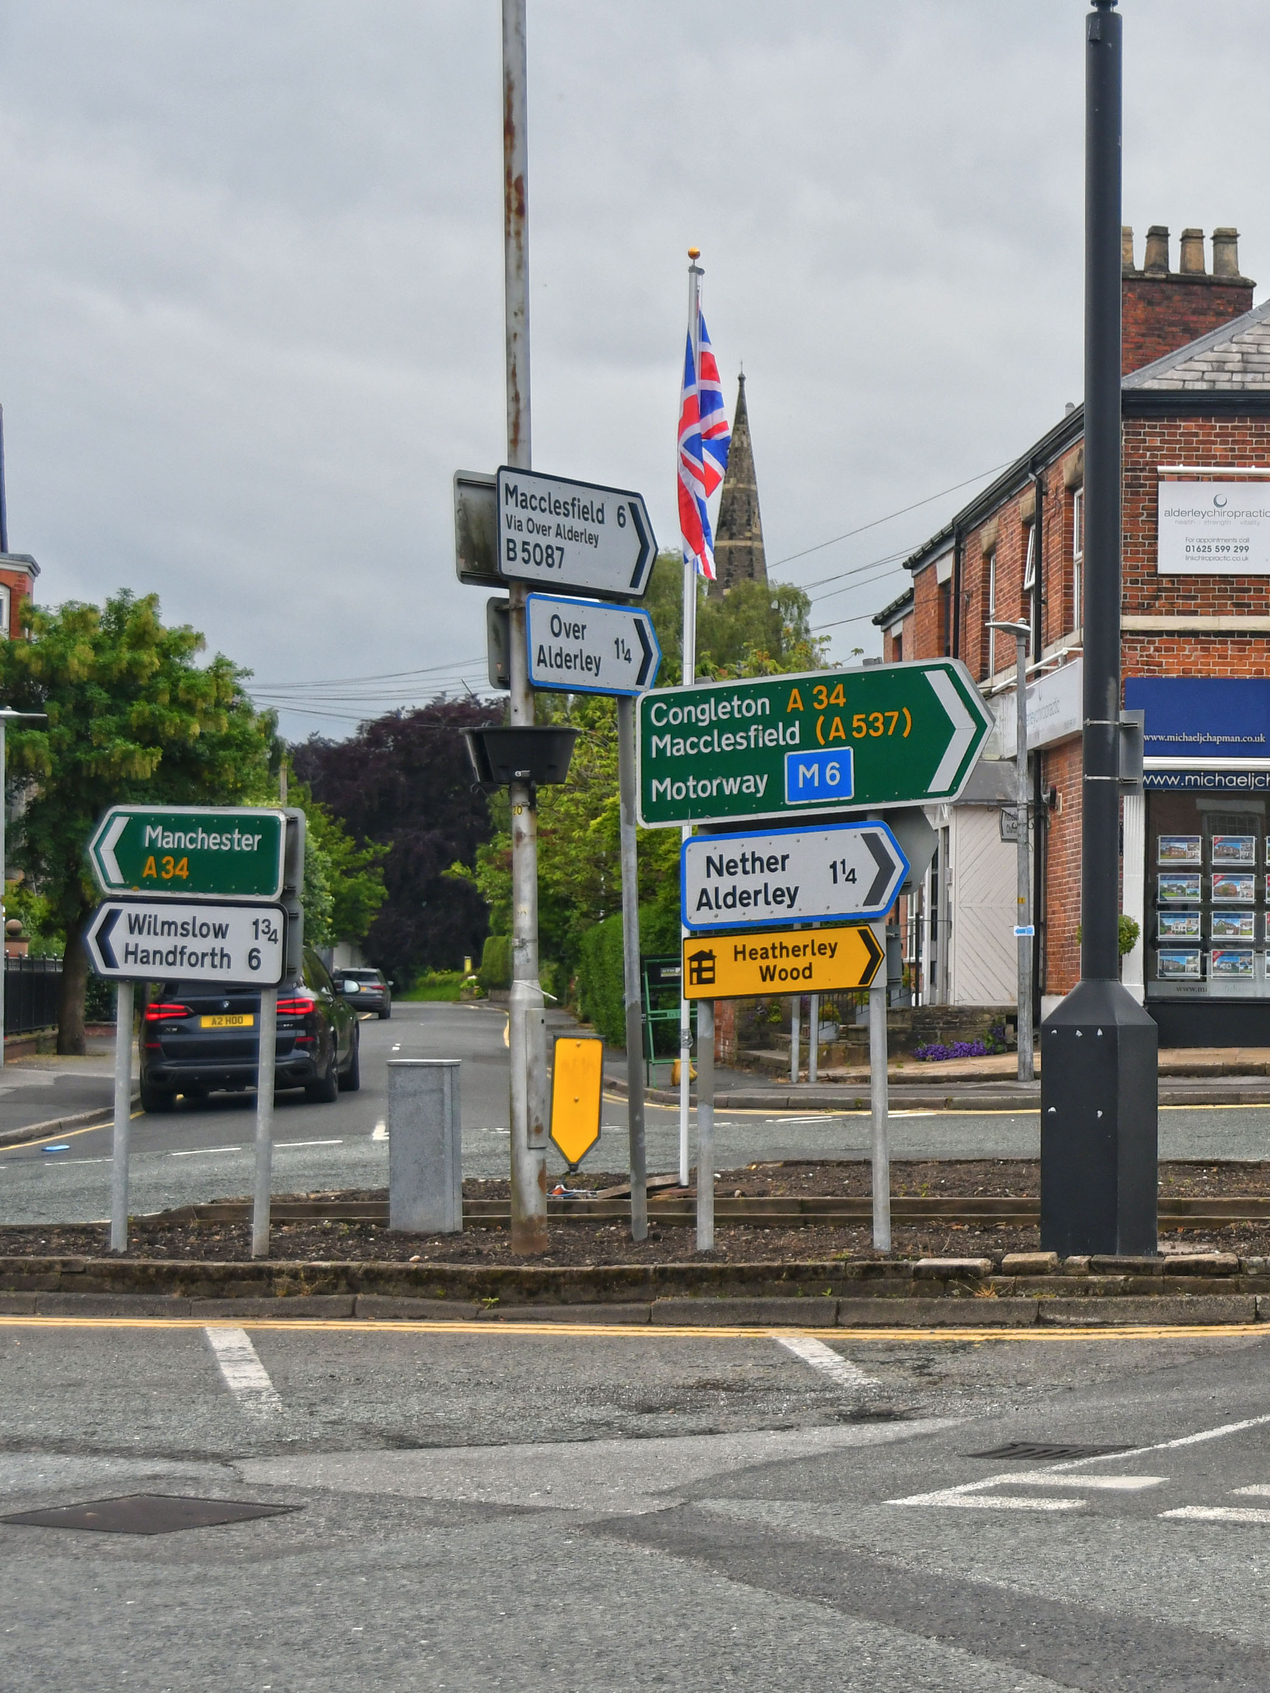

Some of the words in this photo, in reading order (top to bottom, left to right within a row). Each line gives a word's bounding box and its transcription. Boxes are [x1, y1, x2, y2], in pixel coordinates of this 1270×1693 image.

[504, 482, 605, 525] Macclesfield
[617, 505, 627, 529] 6
[505, 513, 524, 532] Via
[526, 517, 552, 537] Over
[555, 523, 600, 549] Alderley
[1185, 545, 1212, 553] 01625
[1214, 545, 1231, 553] 599
[1233, 545, 1250, 553] 299
[550, 613, 587, 640] Over
[536, 644, 601, 677] Alderley
[650, 695, 771, 727] Congleton
[651, 720, 800, 759] Macclesfield
[1143, 732, 1266, 745] www.michaeljchapman.co.uk
[651, 773, 769, 803] Motorway
[144, 824, 263, 851] Manchester
[705, 850, 790, 878] Nether
[696, 882, 800, 911] Alderley
[127, 912, 230, 940] Wilmslow
[124, 942, 232, 970] Handforth
[247, 947, 262, 971] 6
[733, 938, 838, 962] Heatherley
[759, 962, 813, 982] Wood
[211, 1016, 223, 1026] A2
